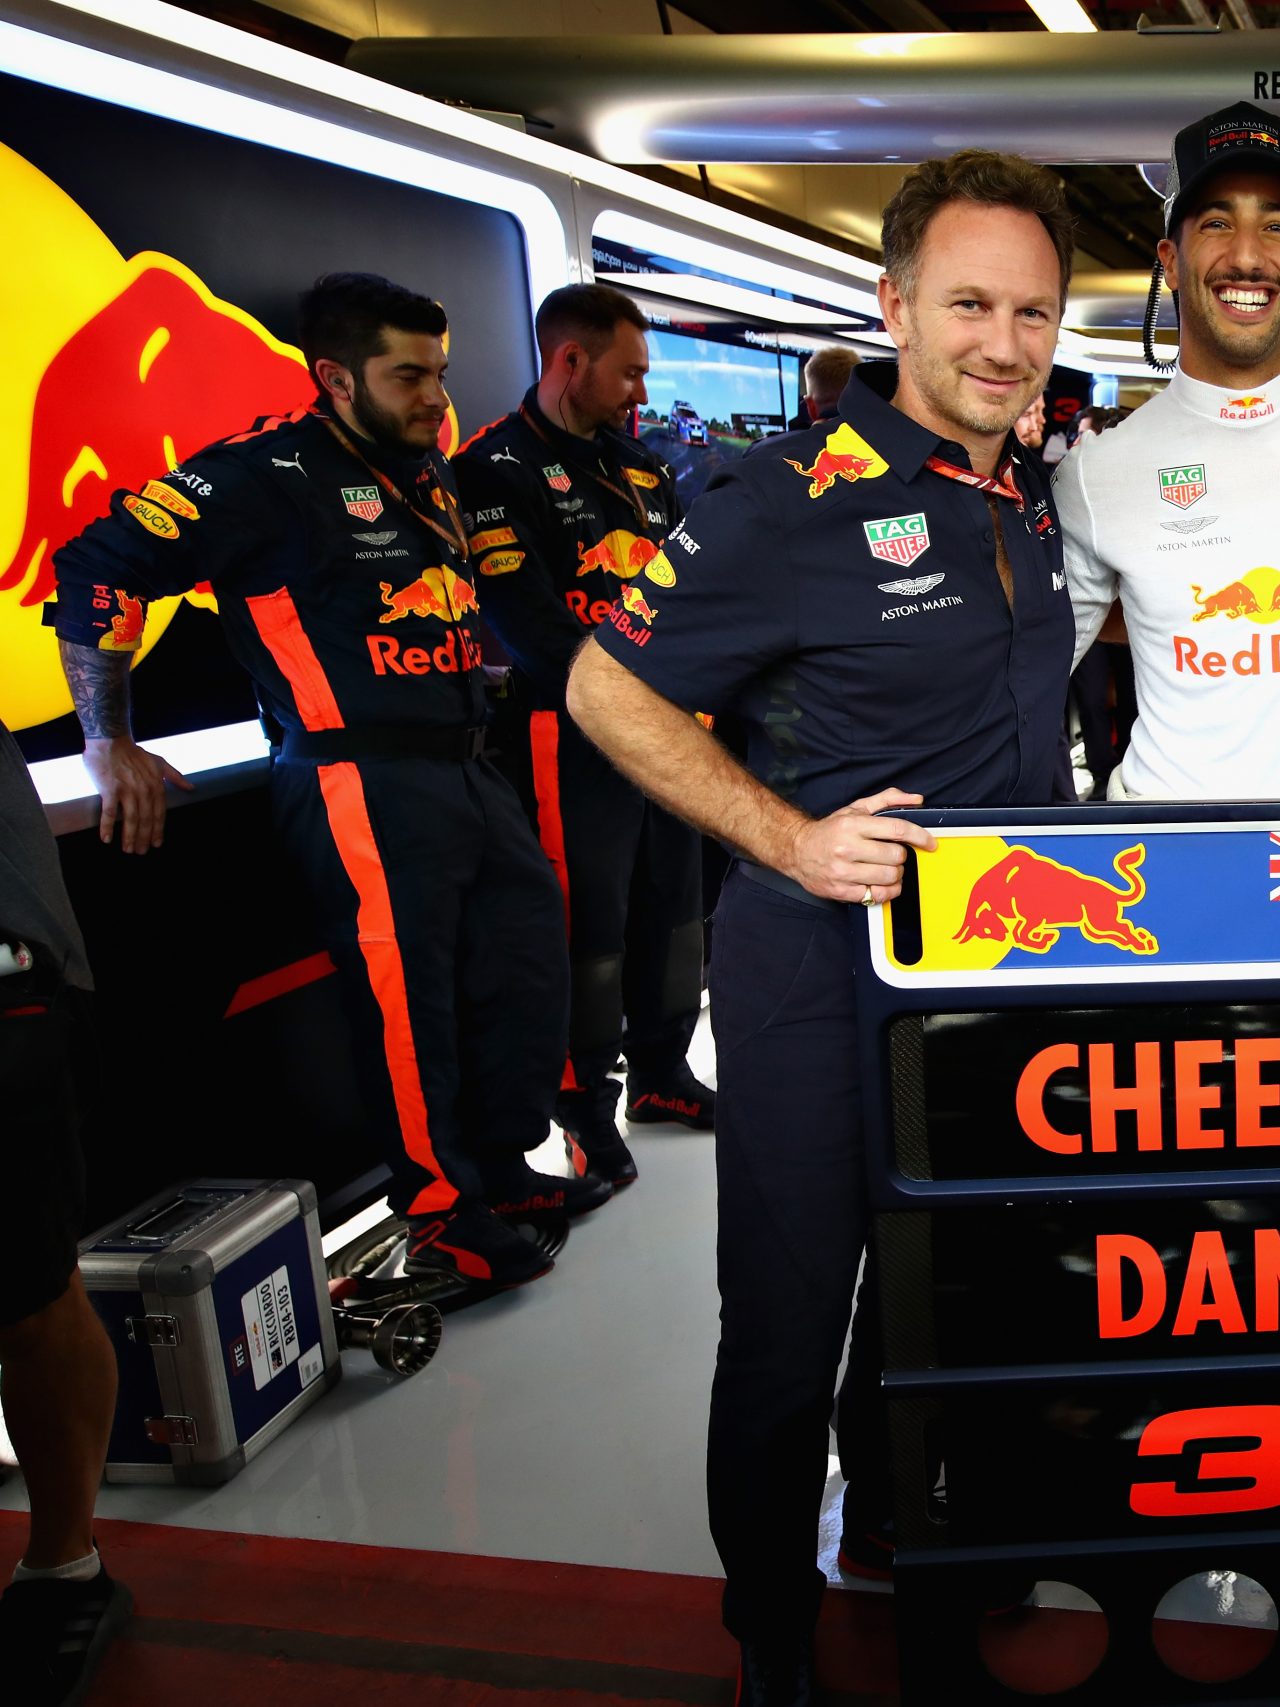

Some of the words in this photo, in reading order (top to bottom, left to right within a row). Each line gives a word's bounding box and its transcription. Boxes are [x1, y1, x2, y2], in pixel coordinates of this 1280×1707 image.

[1209, 121, 1239, 135] ASTON
[1242, 121, 1279, 135] MARTIN
[1209, 134, 1228, 147] Red
[1228, 131, 1248, 140] Bull
[1209, 140, 1280, 153] RACING
[1054, 397, 1081, 421] 3
[1220, 408, 1246, 420] Red
[1249, 404, 1274, 419] Bull
[1163, 468, 1200, 484] TAG
[346, 489, 377, 500] TAG
[1163, 485, 1204, 507] HEUER
[133, 504, 173, 534] RAUCH
[349, 502, 382, 520] HEUER
[476, 507, 505, 523] AT&T
[869, 519, 923, 539] TAG
[355, 551, 383, 560] ASTON
[385, 549, 409, 558] MARTIN
[677, 532, 702, 555] AT&T
[875, 535, 926, 565] HEUER
[1156, 542, 1187, 552] ASTON
[1192, 536, 1231, 548] MARTIN
[490, 555, 521, 569] RAUCH
[881, 603, 920, 621] ASTON
[922, 596, 964, 612] MARTIN
[615, 613, 652, 647] Bull
[366, 630, 456, 675] Red
[1173, 633, 1260, 678] Red
[649, 1094, 676, 1110] Red
[677, 1100, 700, 1117] Bull
[260, 1282, 280, 1348] RICCIARDO
[276, 1284, 296, 1346] RB14-103
[234, 1343, 245, 1368] RTE
